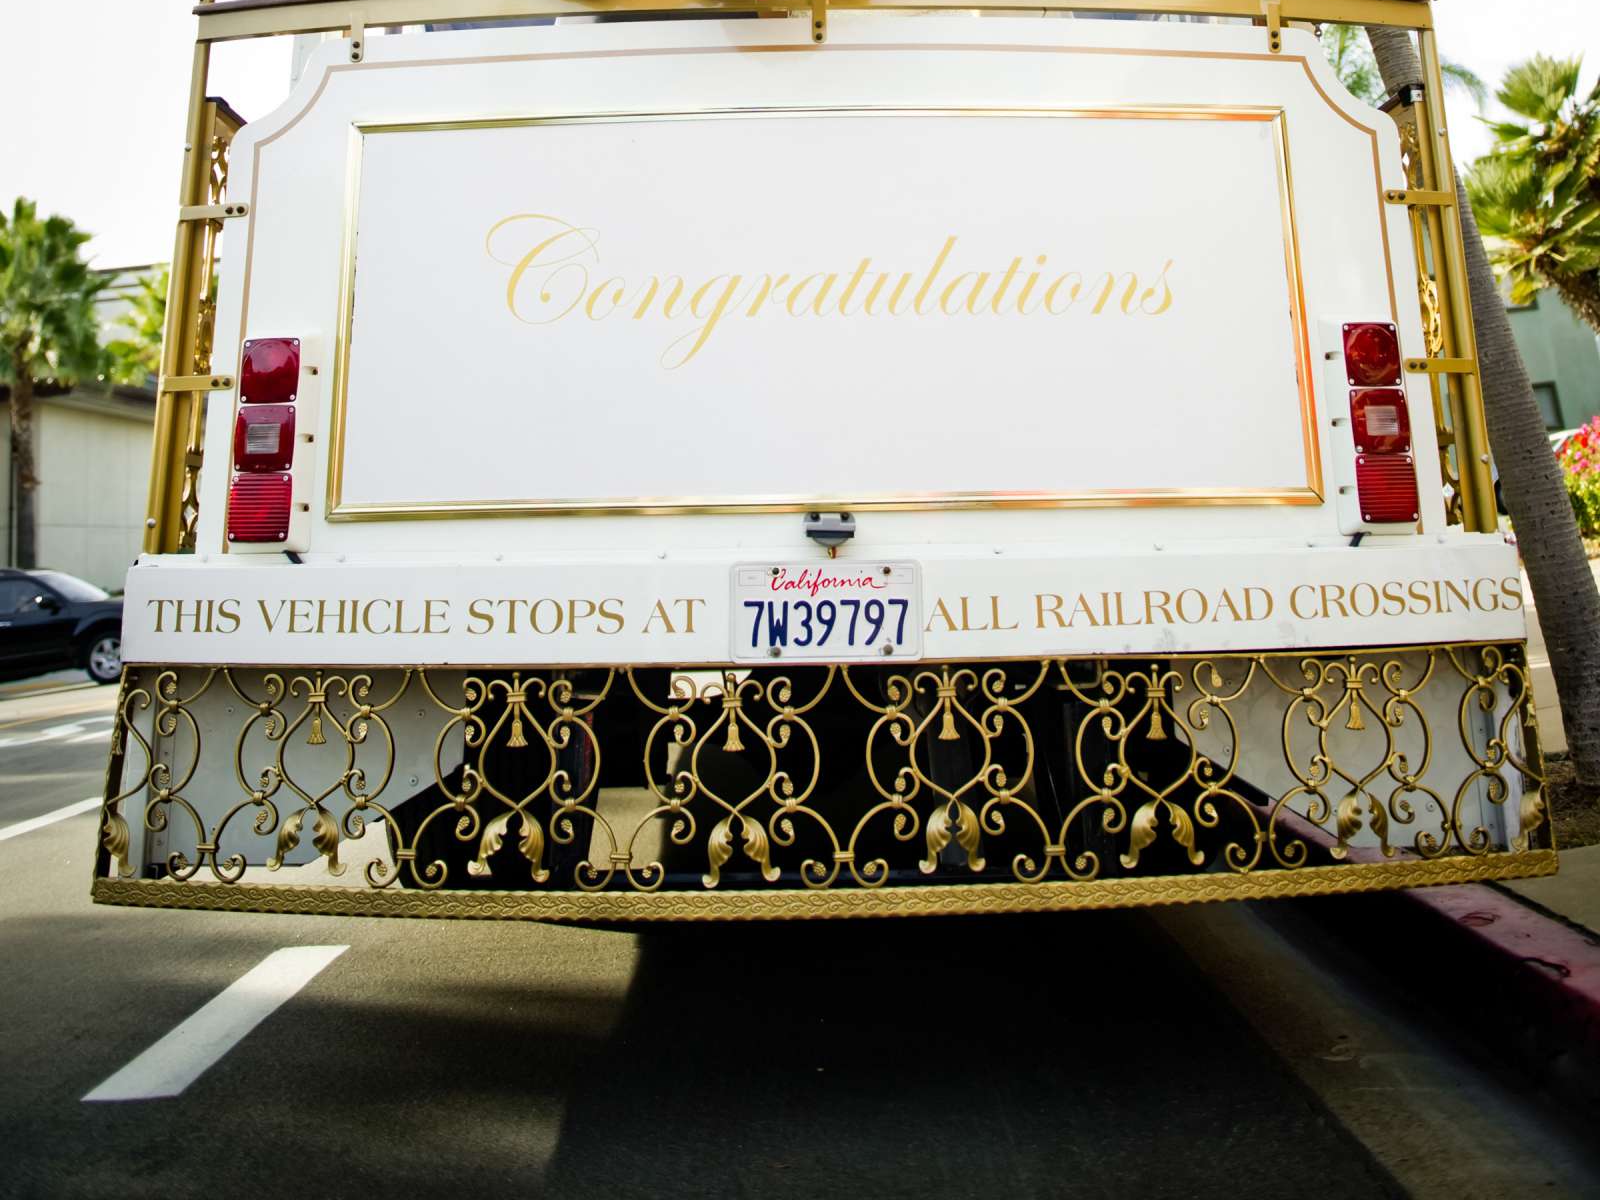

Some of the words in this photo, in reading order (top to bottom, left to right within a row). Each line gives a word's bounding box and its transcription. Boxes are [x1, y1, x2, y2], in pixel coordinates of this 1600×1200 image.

[486, 213, 1174, 370] Congratulations
[146, 598, 241, 634] THIS
[257, 598, 450, 634] VEHICLE
[467, 599, 625, 635] STOPS
[642, 598, 706, 634] AT
[924, 596, 1019, 633] ALL
[1035, 586, 1275, 629] RAILROAD
[1289, 576, 1523, 620] CROSSINGS
[771, 568, 887, 597] California
[744, 599, 909, 647] 7W39797
